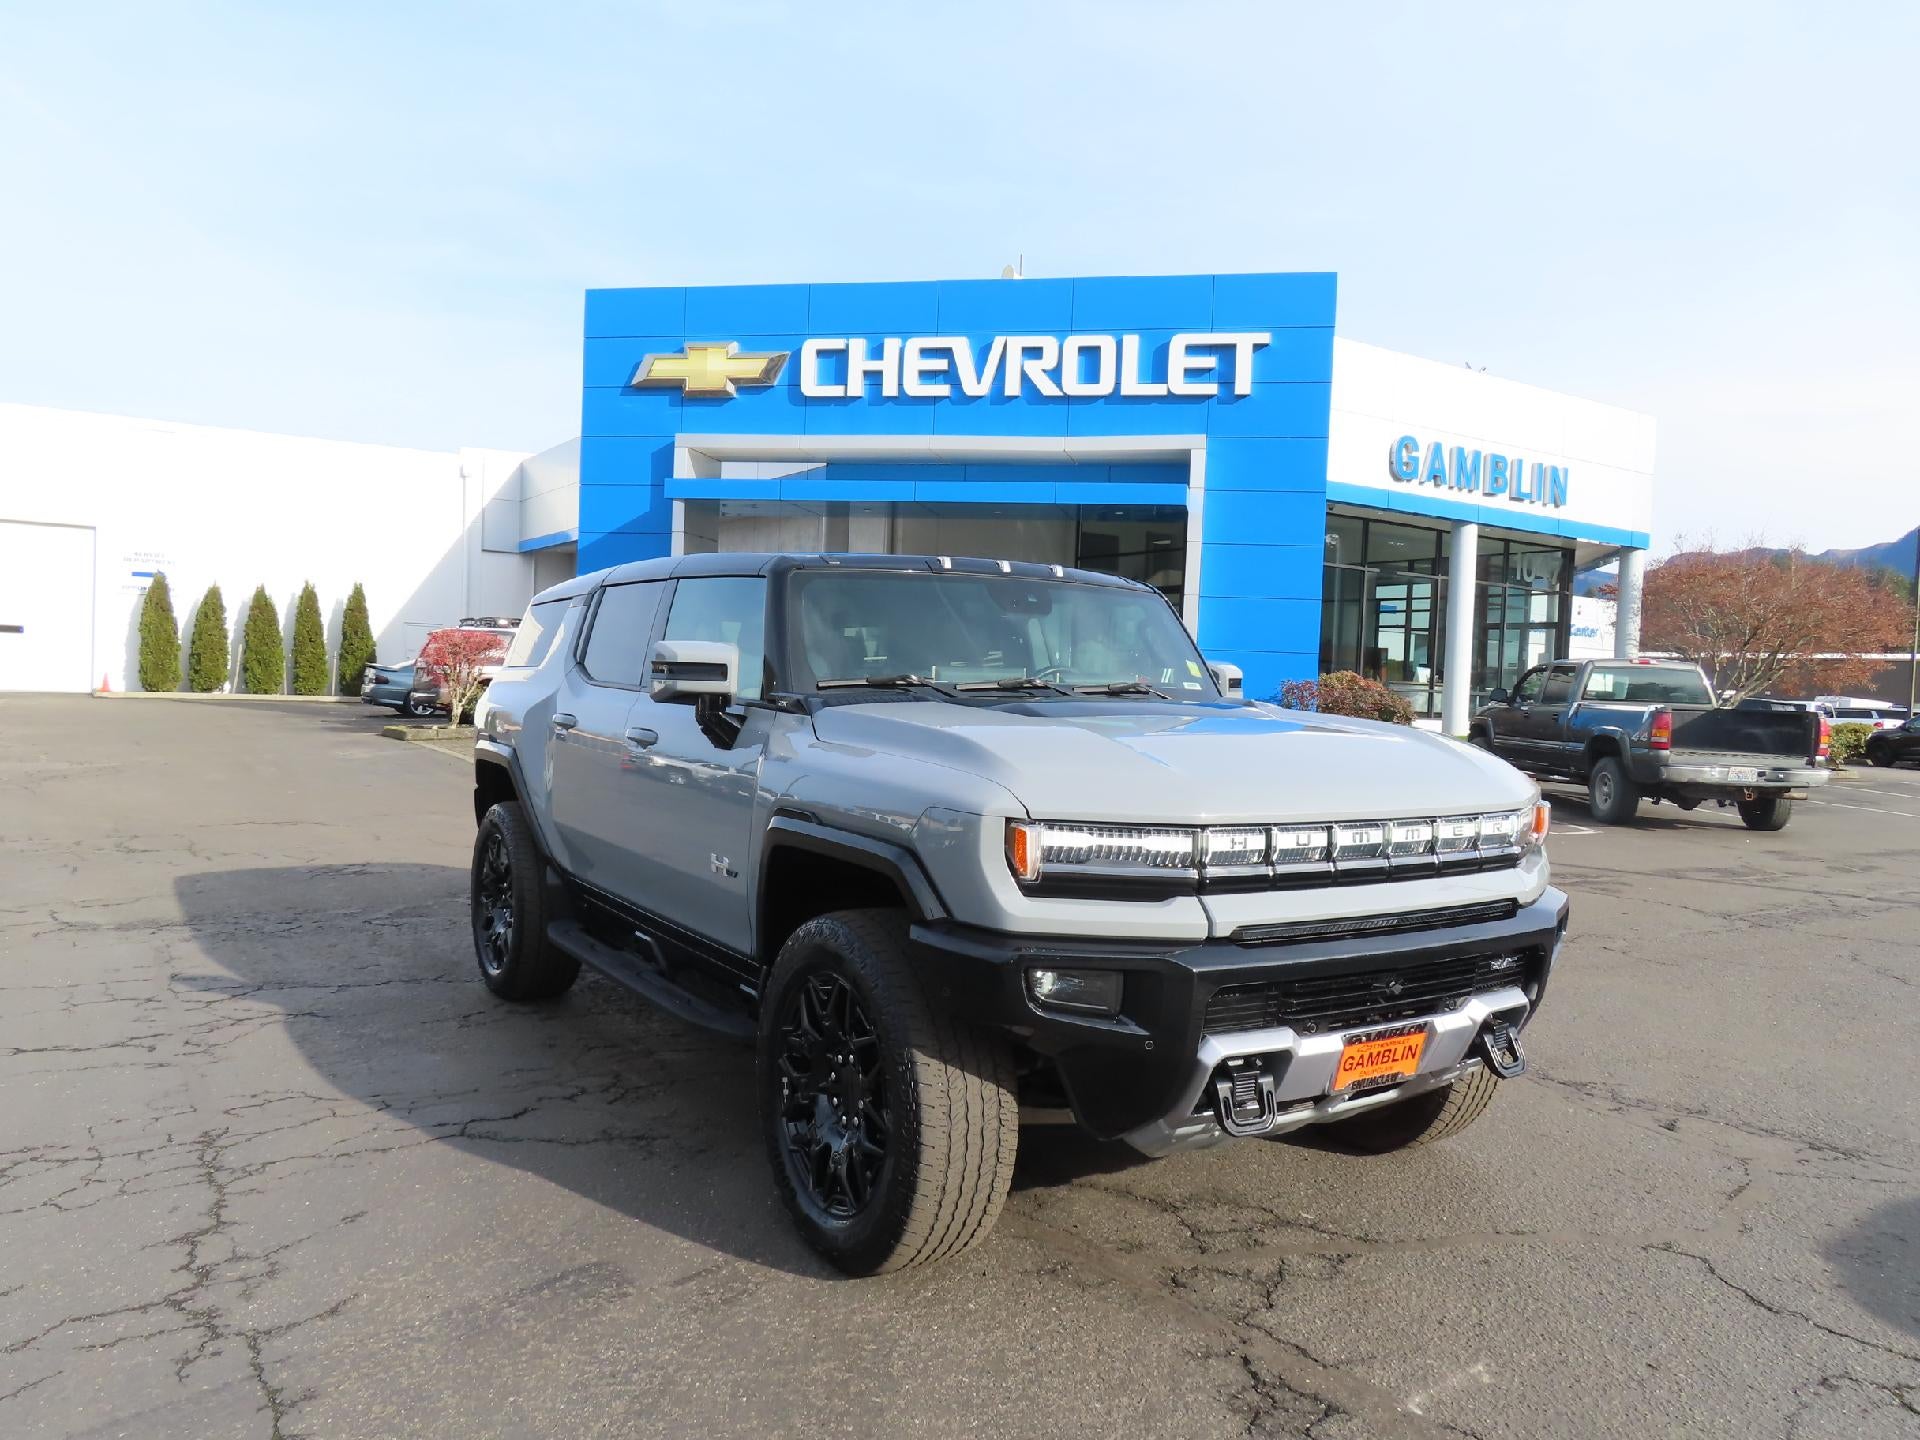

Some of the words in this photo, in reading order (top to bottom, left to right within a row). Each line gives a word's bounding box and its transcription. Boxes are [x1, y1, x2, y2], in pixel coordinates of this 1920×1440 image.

[800, 332, 1272, 397] CHEVROLET
[1390, 435, 1569, 508] GAMBLIN
[1230, 821, 1503, 850] HUMMER
[1343, 1044, 1418, 1071] GAMBLIN
